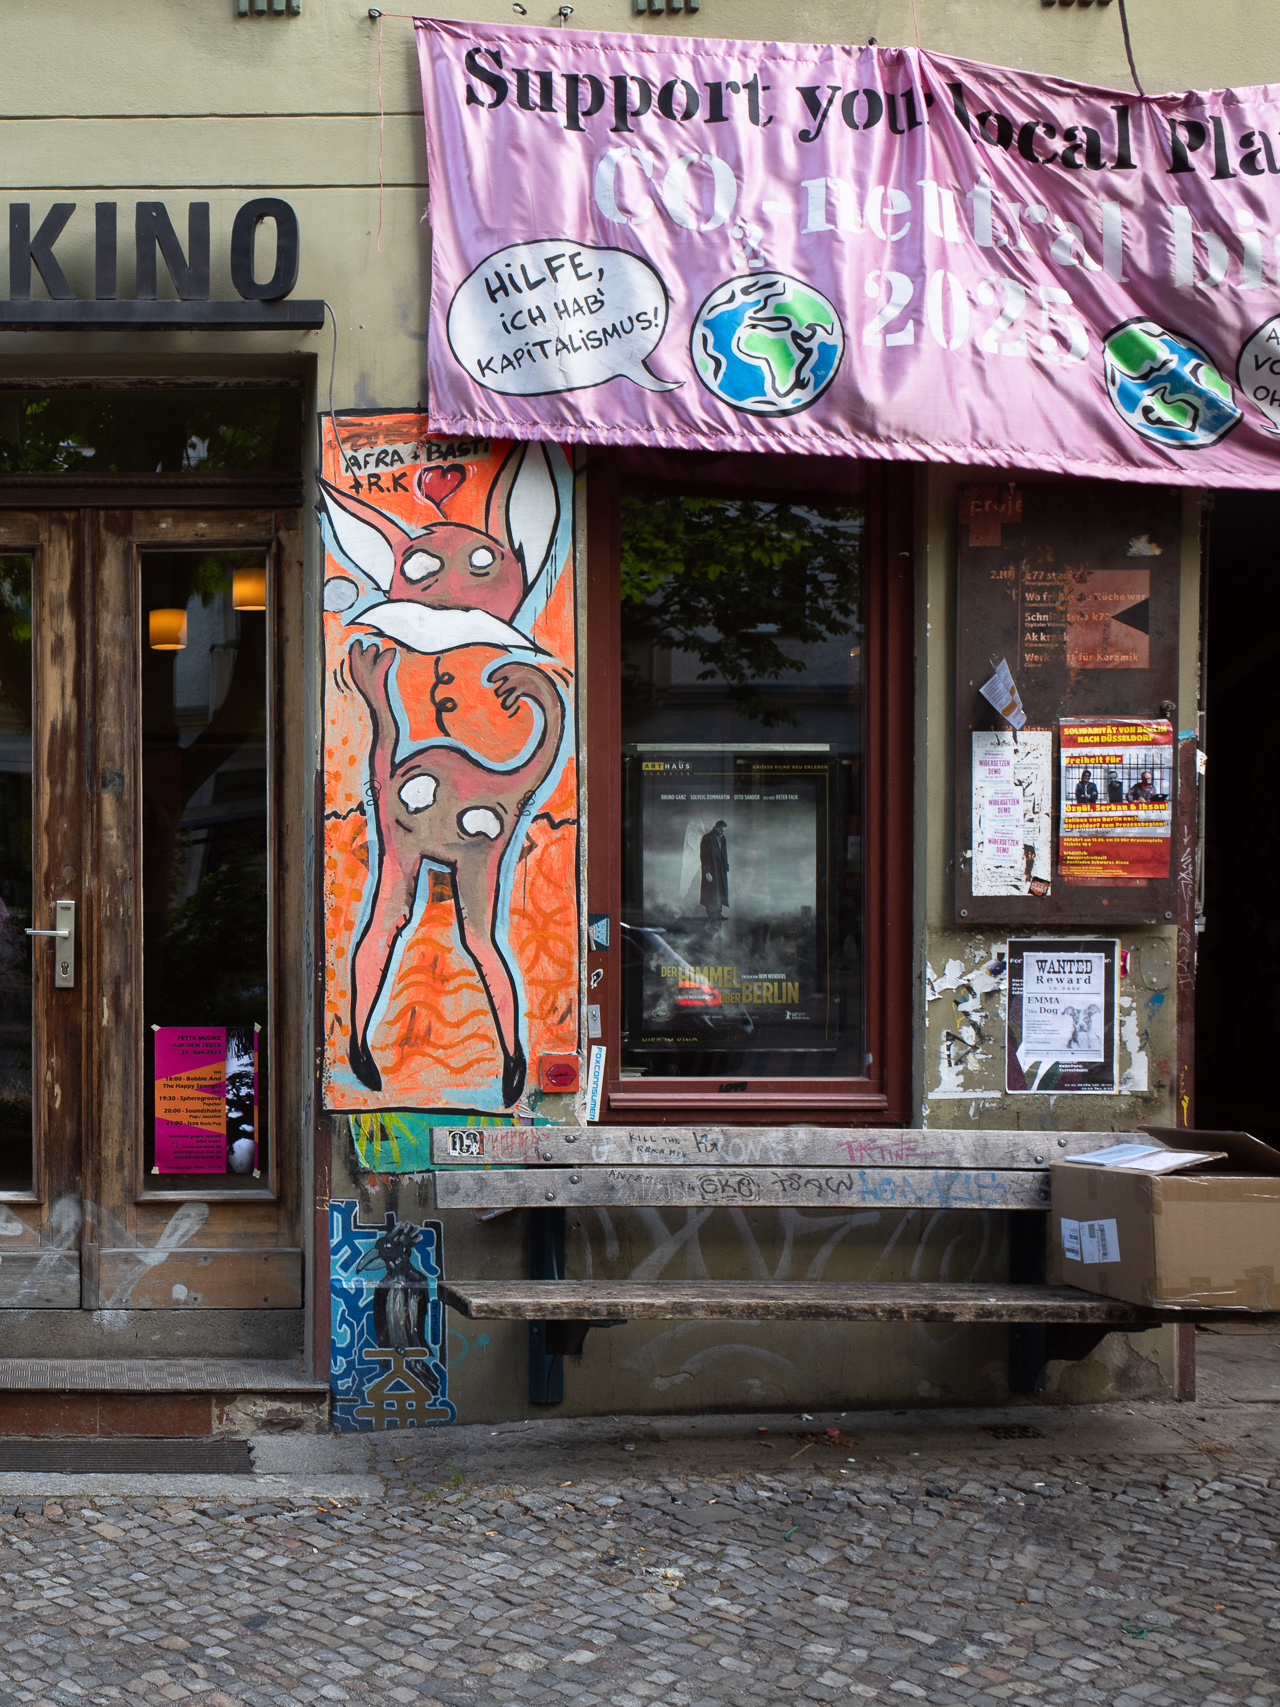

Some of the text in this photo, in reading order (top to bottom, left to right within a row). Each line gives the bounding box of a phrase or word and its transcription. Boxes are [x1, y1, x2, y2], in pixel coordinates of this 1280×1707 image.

[464, 46, 774, 133] Support
[796, 83, 934, 144] your
[946, 82, 1138, 170] local
[9, 197, 301, 301] KINO
[861, 267, 1091, 365] 2025
[344, 449, 406, 474] AFRA
[1025, 593, 1041, 601] Wo
[1025, 633, 1038, 642] Ak
[1078, 652, 1094, 661] für
[1063, 726, 1136, 735] SOLIDARITÄT VON
[1101, 734, 1154, 743] DÜSSELDORF
[979, 759, 1010, 767] WIDERSETZEN
[1065, 756, 1104, 764] Freiheit
[642, 762, 692, 770] ARTHAUS
[988, 798, 1020, 806] WIDERSETZEN
[997, 806, 1011, 814] DEMO
[987, 837, 1020, 847] WIDERSETZEN
[995, 846, 1009, 854] DEMO
[1035, 959, 1093, 975] WANTED
[661, 966, 741, 988] DER HIMMEL
[1036, 976, 1092, 985] Reward
[742, 981, 800, 1004] BERLIN
[1027, 996, 1060, 1004] EMMA
[718, 1081, 748, 1093] LOVE
